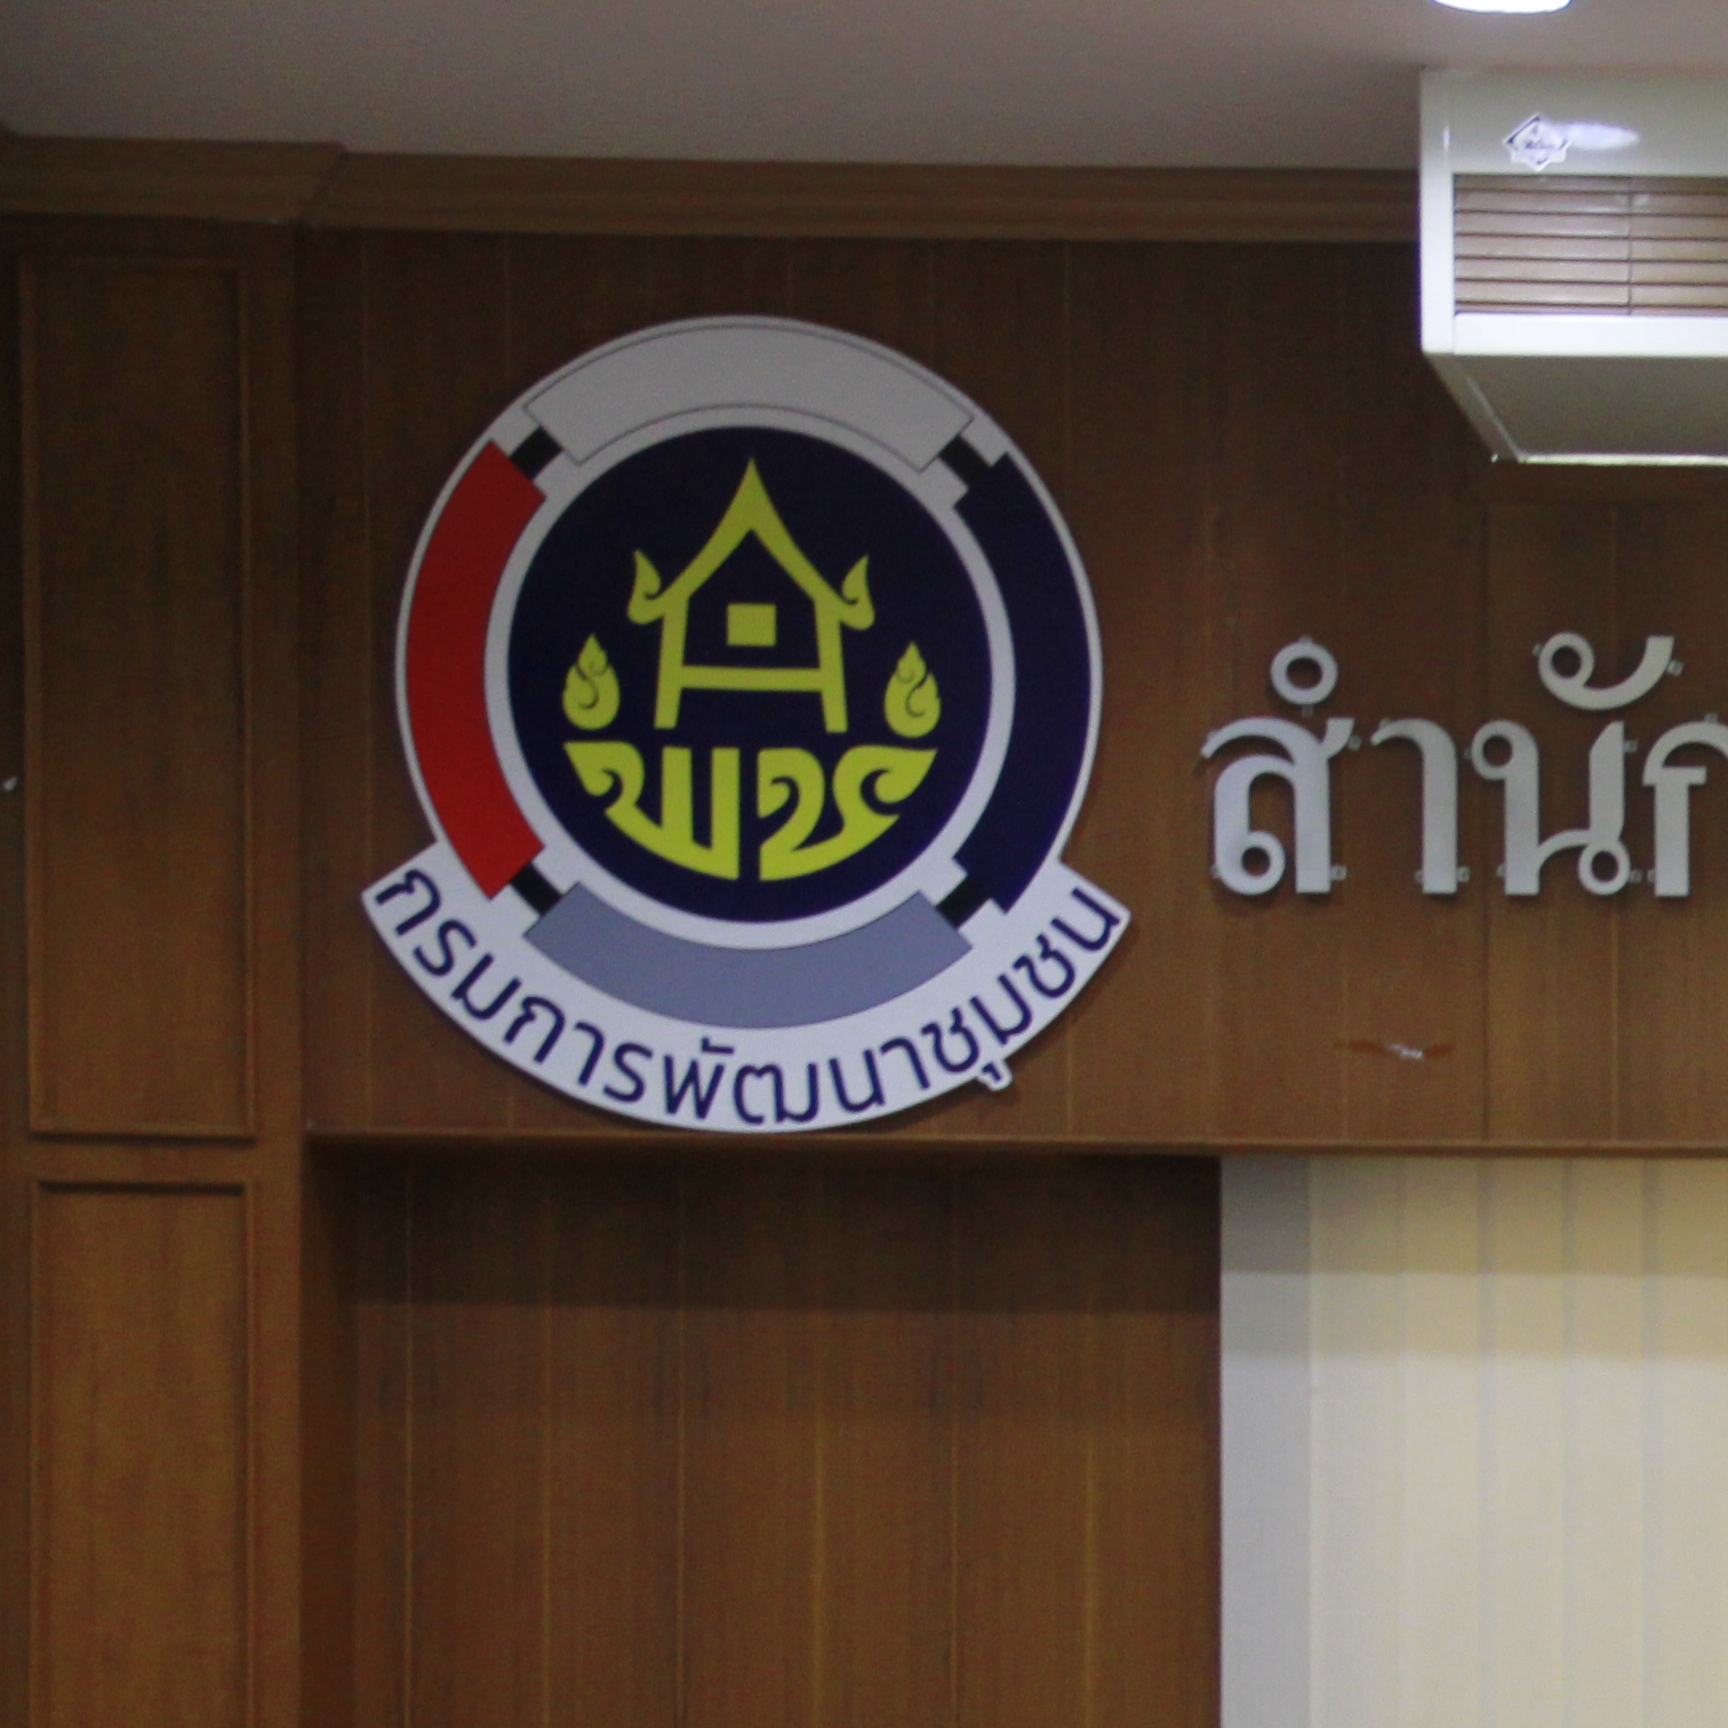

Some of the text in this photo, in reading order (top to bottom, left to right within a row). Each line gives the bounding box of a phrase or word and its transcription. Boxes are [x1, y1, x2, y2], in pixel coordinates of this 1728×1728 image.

[374, 867, 1122, 1126] กรมการพัฒนาชุมชน
